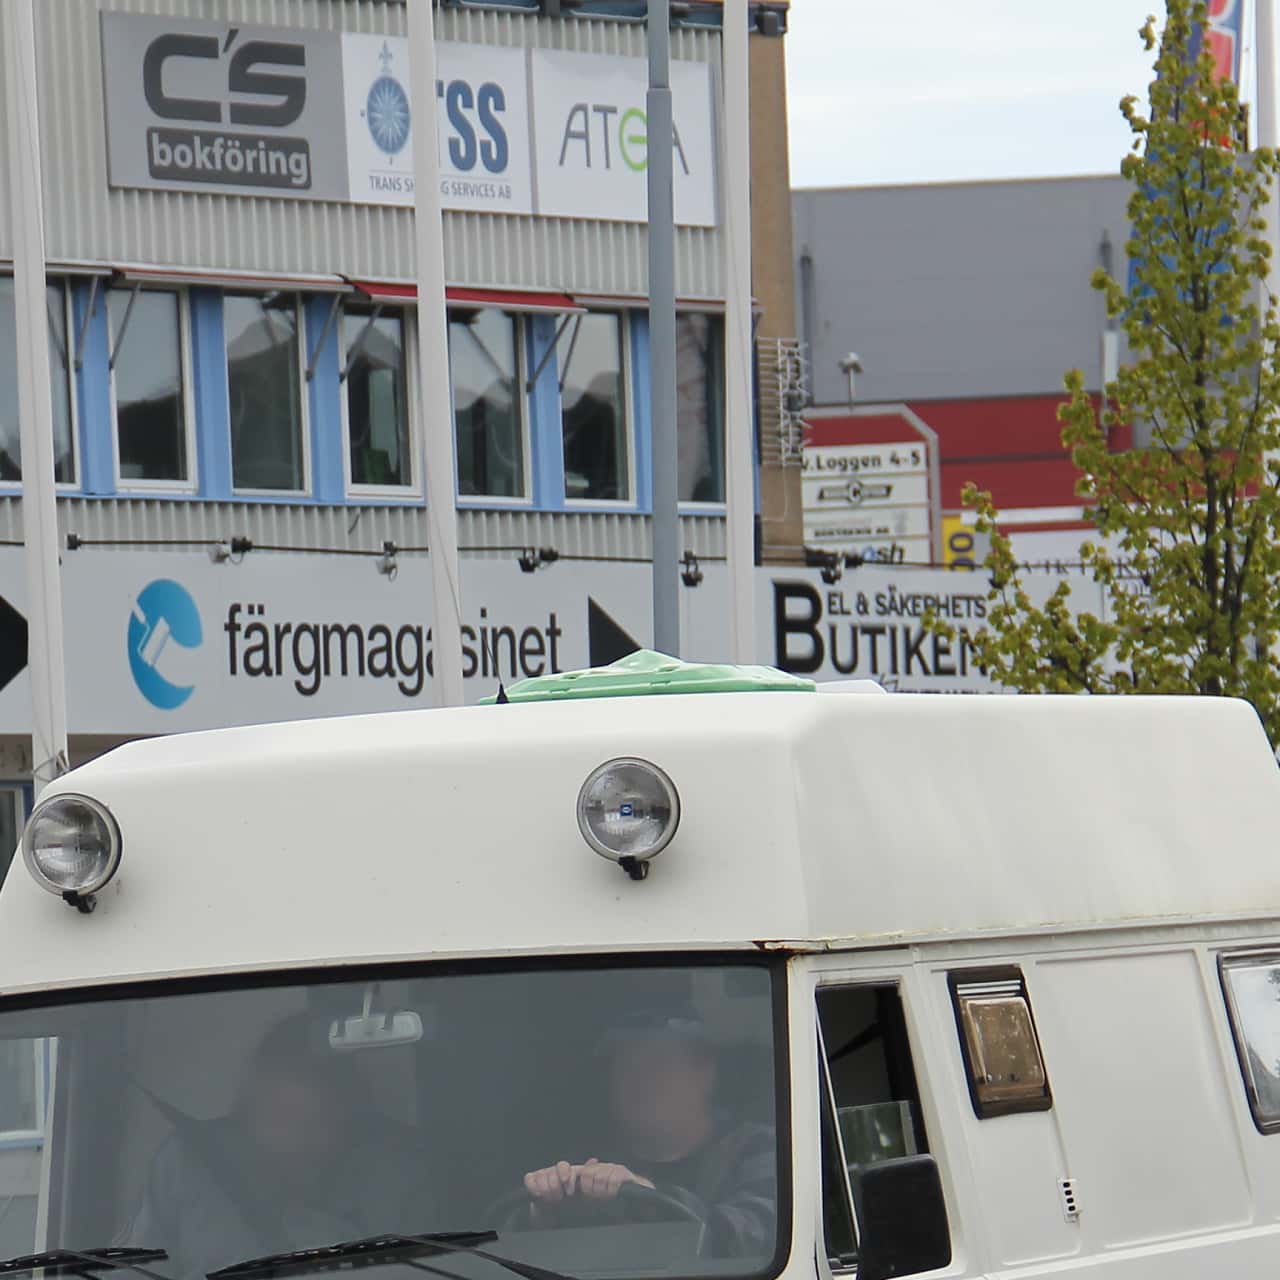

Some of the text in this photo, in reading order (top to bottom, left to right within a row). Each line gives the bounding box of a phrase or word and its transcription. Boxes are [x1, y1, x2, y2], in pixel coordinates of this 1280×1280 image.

[436, 79, 509, 174] SS
[152, 135, 309, 184] bokföring
[369, 175, 402, 192] TRANS
[451, 178, 496, 198] SERVICES
[498, 183, 511, 199] AB
[827, 592, 851, 616] EL
[857, 592, 869, 615] &
